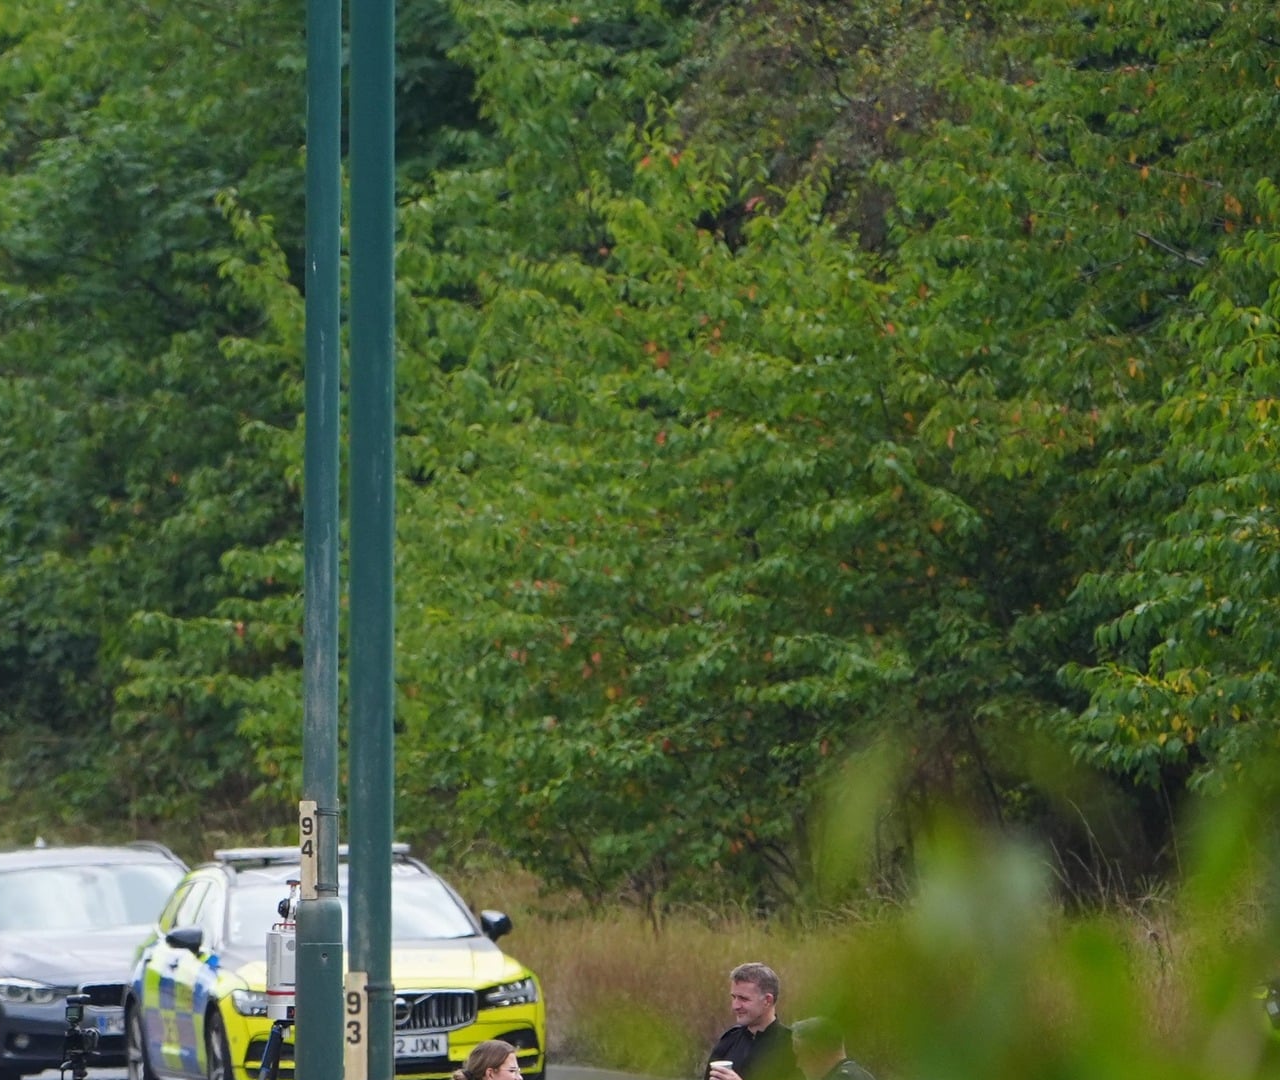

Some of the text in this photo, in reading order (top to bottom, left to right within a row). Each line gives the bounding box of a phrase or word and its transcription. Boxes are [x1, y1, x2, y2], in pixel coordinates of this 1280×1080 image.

[301, 817, 314, 858] 94
[346, 992, 362, 1044] 93
[411, 1038, 440, 1052] JXN
